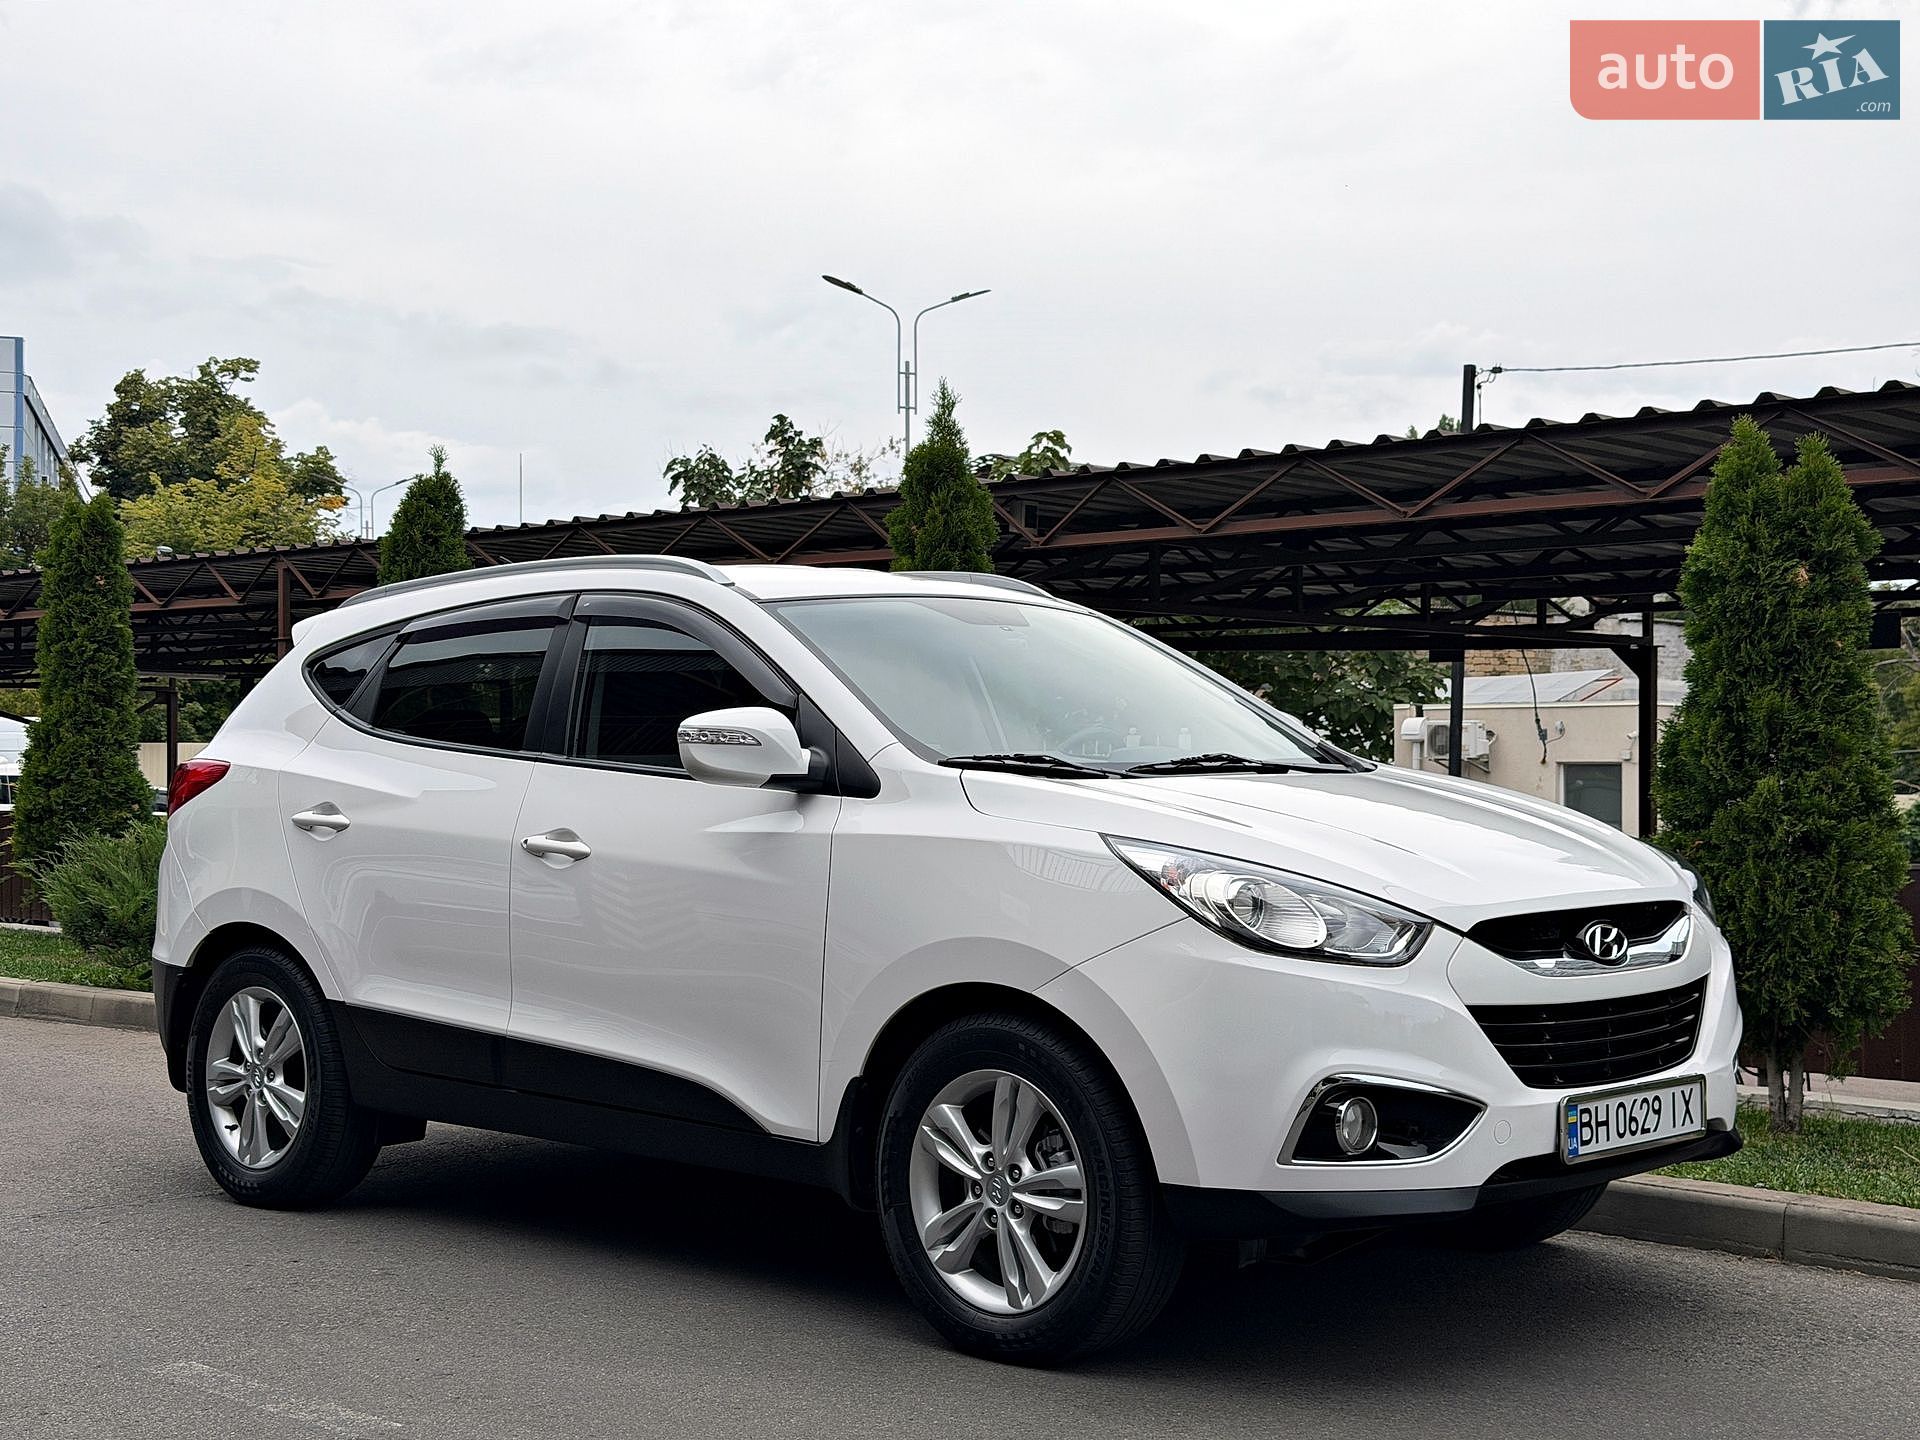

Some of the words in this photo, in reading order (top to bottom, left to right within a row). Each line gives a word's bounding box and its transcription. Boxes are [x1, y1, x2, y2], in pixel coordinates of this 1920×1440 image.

[1579, 1103, 1610, 1147] BH
[1615, 1094, 1662, 1139] 0629
[1671, 1087, 1694, 1128] IX
[1567, 1136, 1578, 1151] UA
